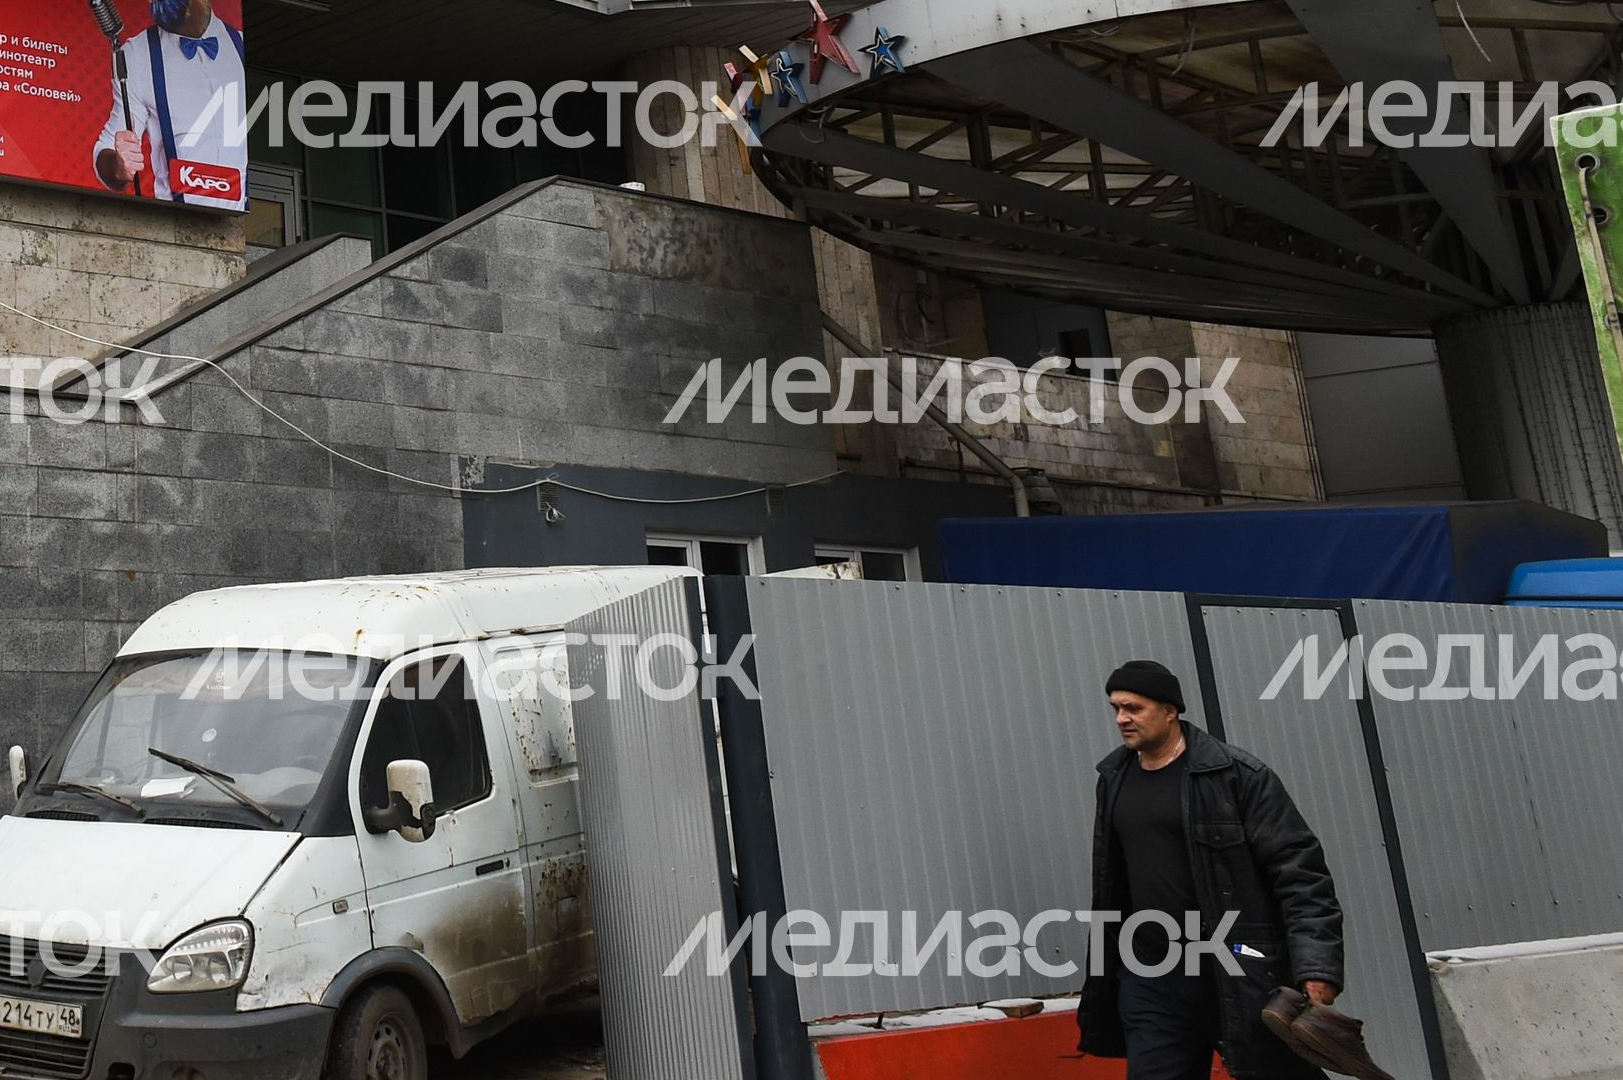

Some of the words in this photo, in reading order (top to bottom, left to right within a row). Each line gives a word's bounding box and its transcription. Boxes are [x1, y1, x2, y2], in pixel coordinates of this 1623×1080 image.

[11, 35, 19, 46] и
[22, 36, 68, 55] билеты
[14, 82, 81, 102] «Соловей»
[180, 165, 230, 192] КАРО
